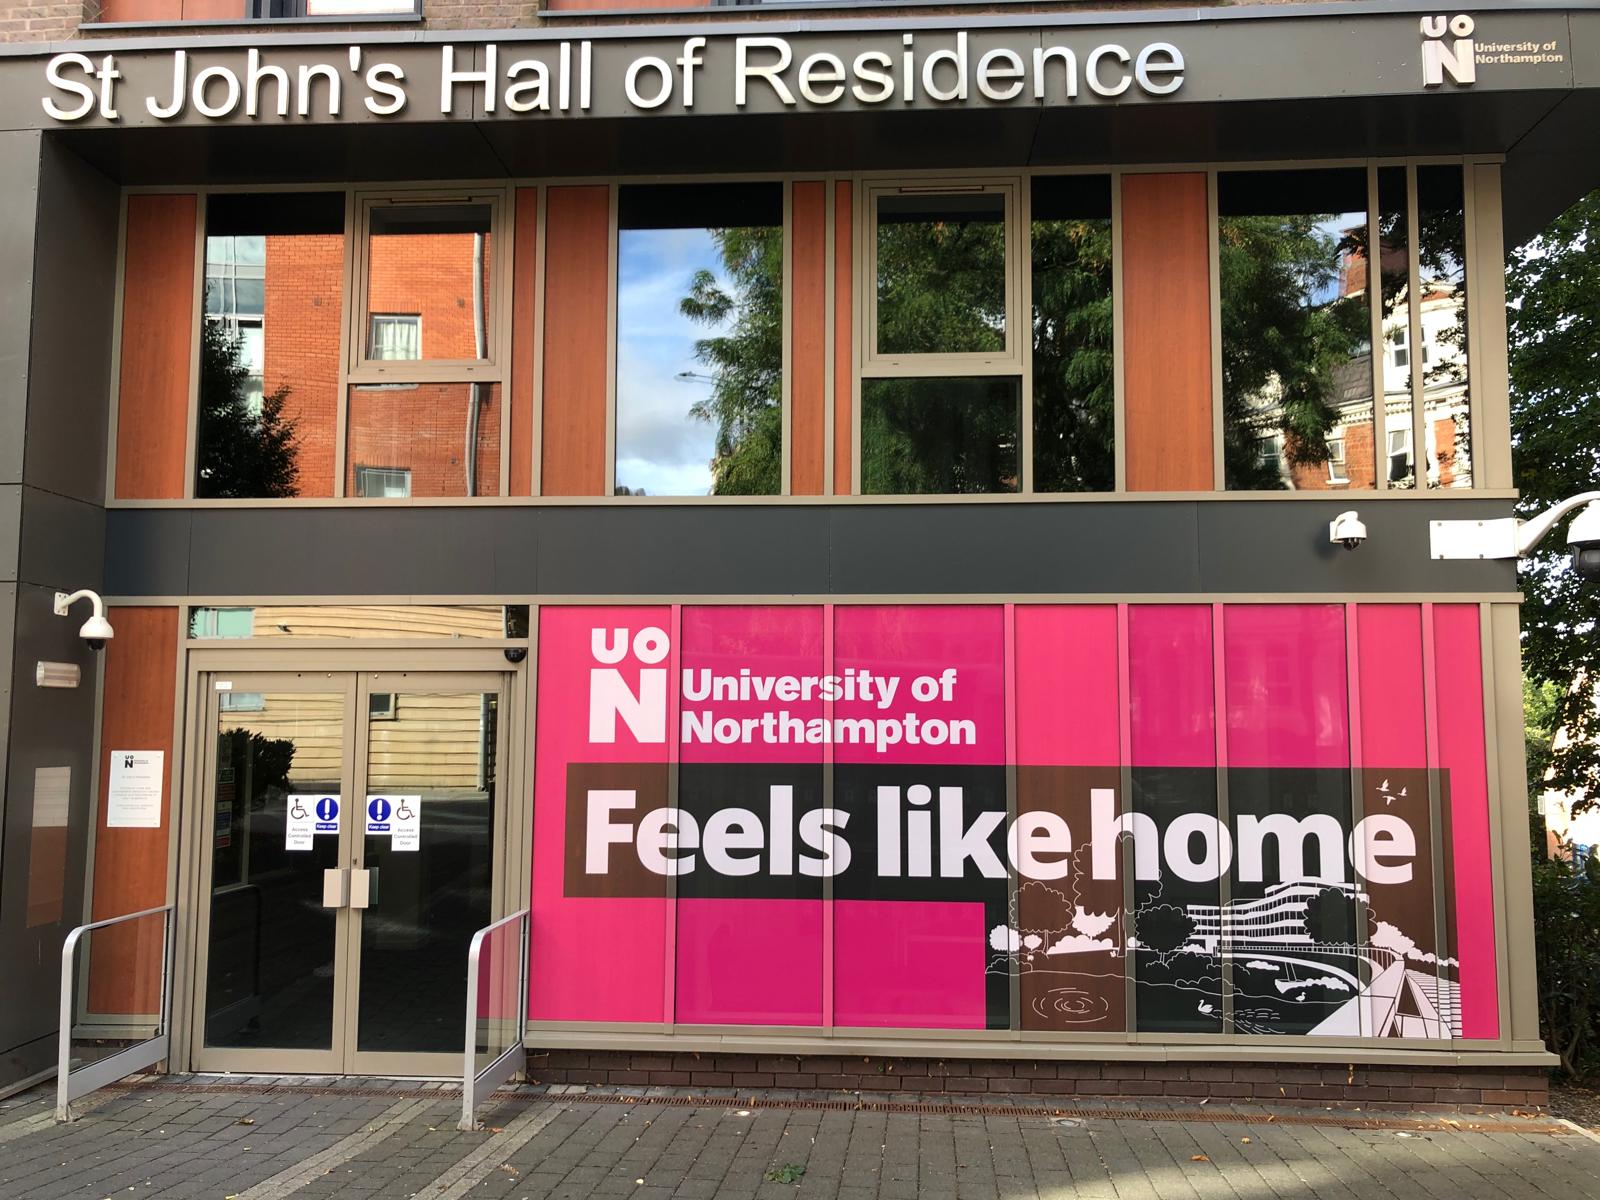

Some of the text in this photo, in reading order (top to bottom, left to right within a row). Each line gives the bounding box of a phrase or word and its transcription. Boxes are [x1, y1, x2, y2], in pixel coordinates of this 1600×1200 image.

[1474, 41, 1557, 54] University of
[1475, 53, 1564, 65] Northampton
[40, 31, 1186, 121] St John's Hall of Residence
[682, 668, 957, 709] University of
[681, 710, 977, 753] Northampton
[585, 784, 1416, 885] Feels like home
